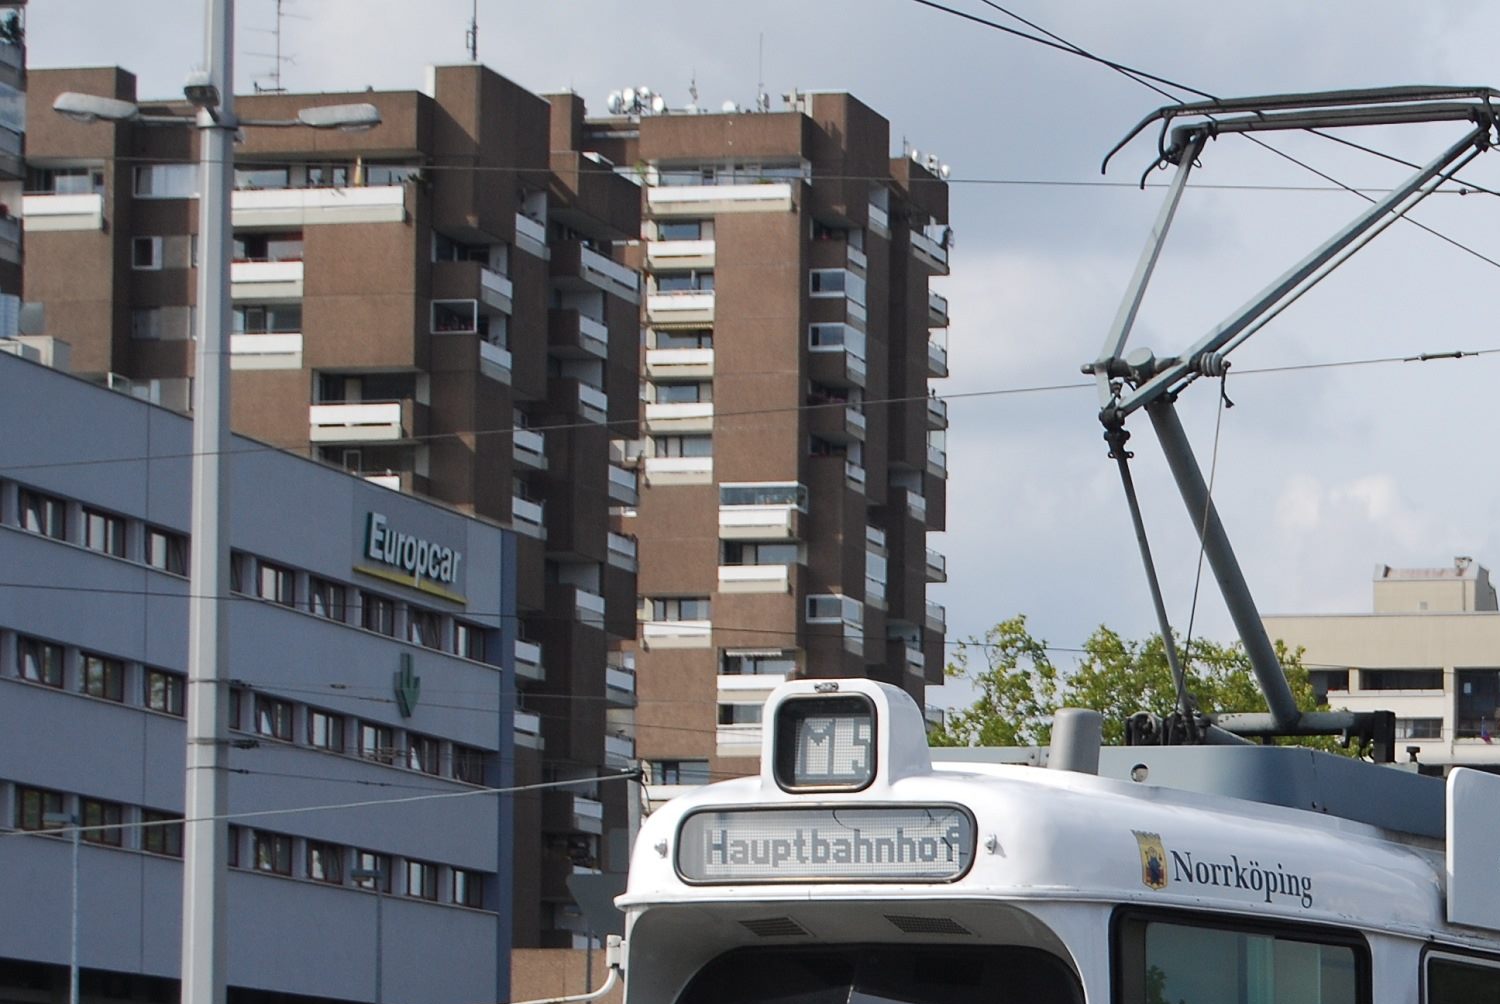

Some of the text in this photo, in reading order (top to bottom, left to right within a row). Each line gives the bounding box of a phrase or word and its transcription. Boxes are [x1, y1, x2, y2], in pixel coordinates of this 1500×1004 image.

[368, 511, 462, 588] Europcar
[706, 827, 960, 868] Hauptbahnhof
[1170, 850, 1313, 909] Norrköping
